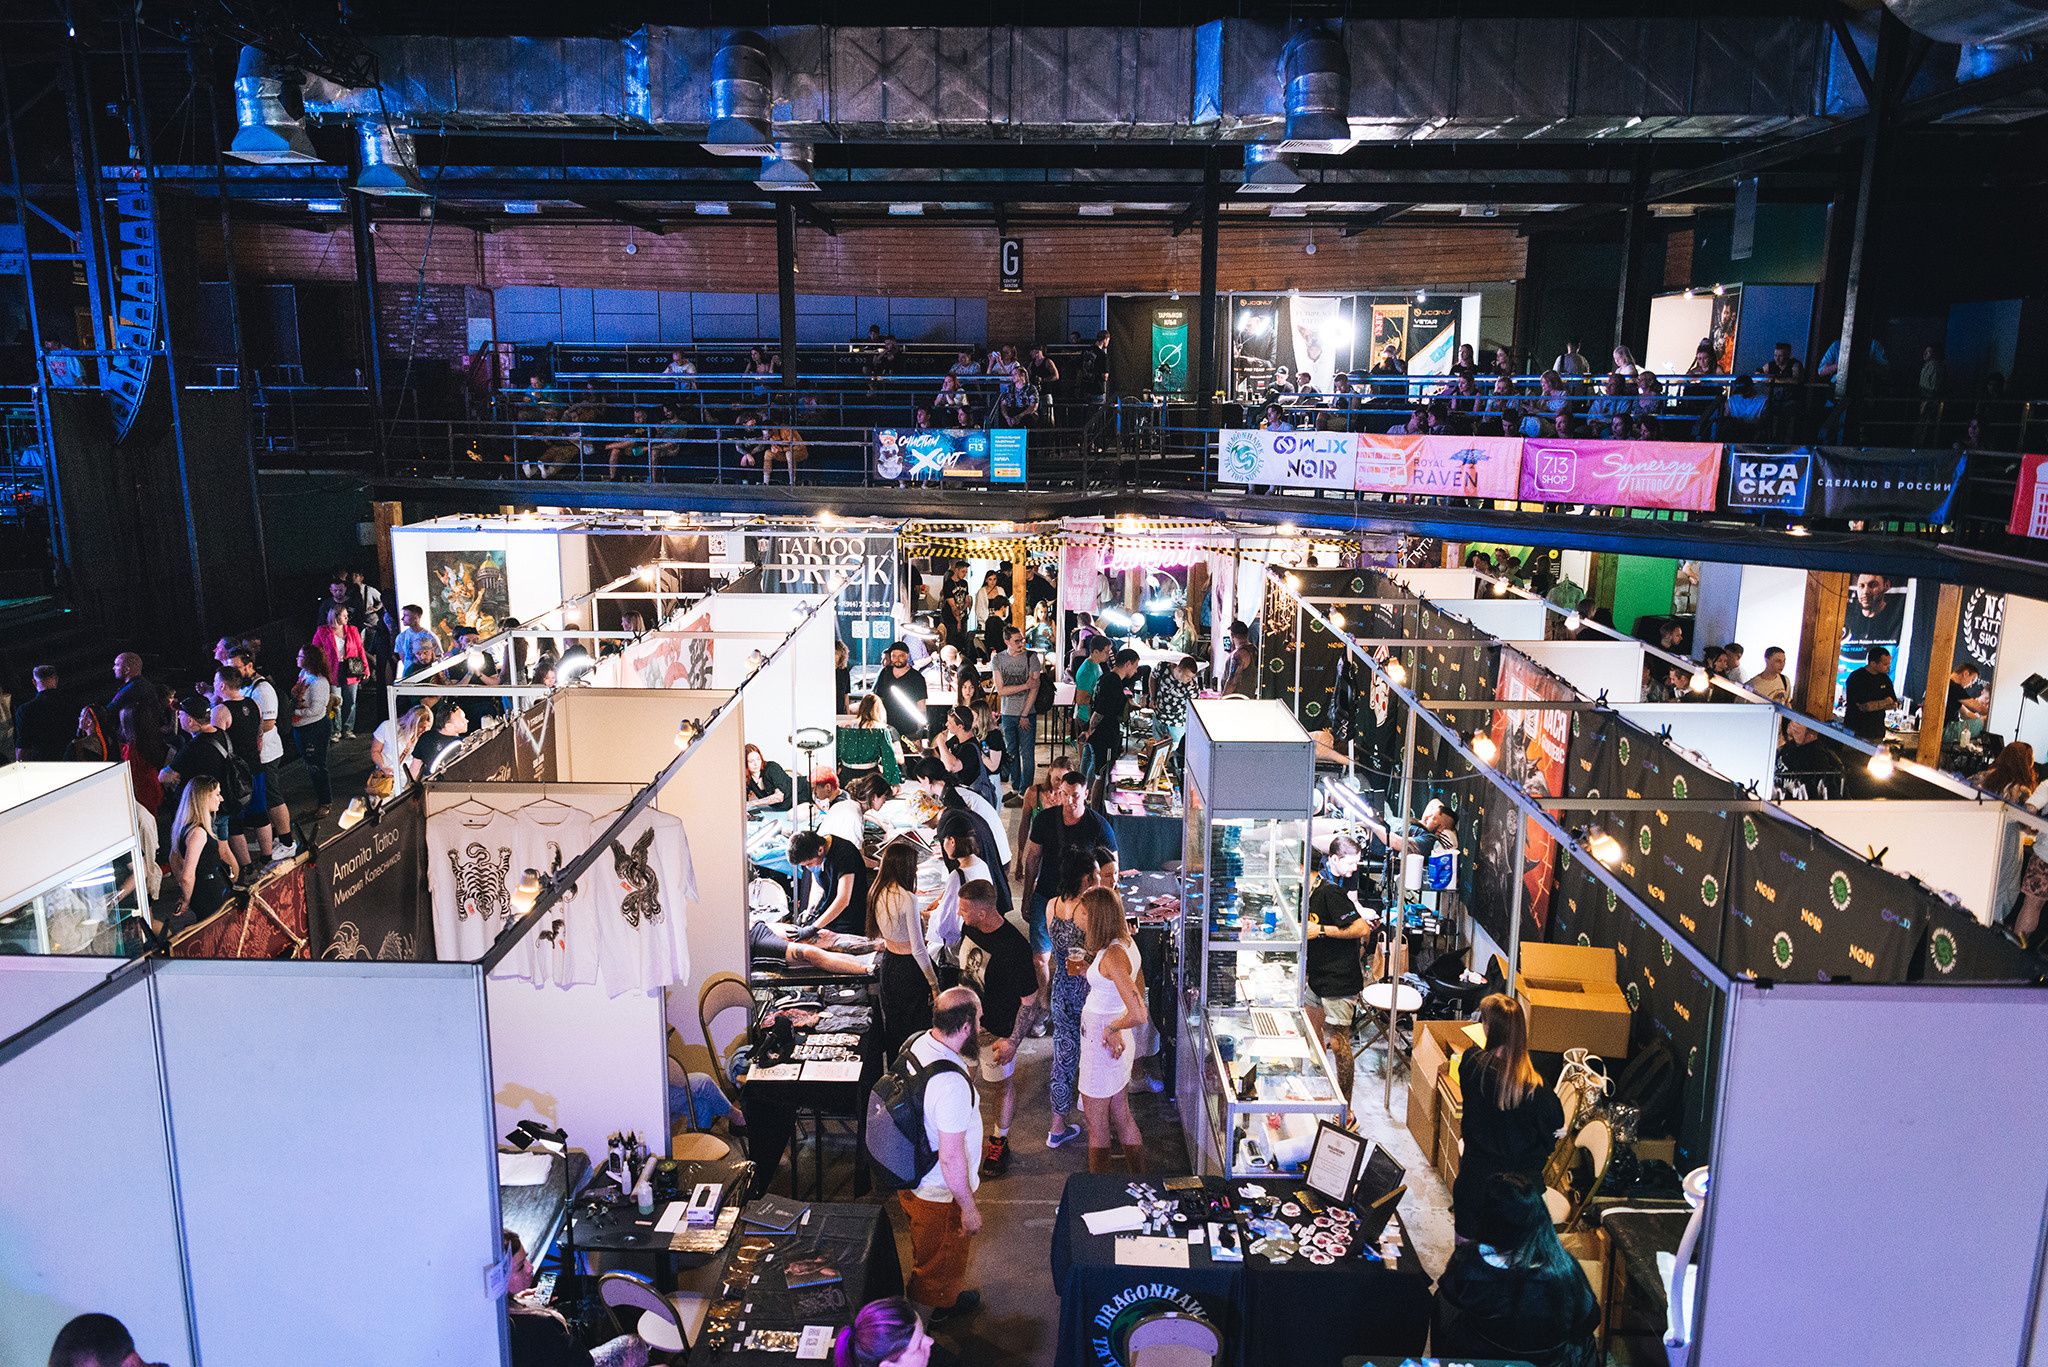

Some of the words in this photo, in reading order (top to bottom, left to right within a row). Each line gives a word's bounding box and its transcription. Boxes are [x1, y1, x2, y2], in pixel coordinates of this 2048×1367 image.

[1003, 241, 1019, 276] G
[968, 444, 984, 452] F13
[1224, 457, 1244, 482] TATTOO
[1245, 458, 1264, 481] SUPPLY
[1287, 458, 1337, 479] NOIR
[1413, 458, 1445, 468] ROYAL
[1592, 453, 1700, 491] Synergy
[1740, 462, 1798, 480] КРА
[1413, 469, 1478, 488] RAVEN
[1541, 475, 1568, 484] SHOP
[1629, 478, 1663, 491] TATTOO
[1737, 479, 1797, 496] СКА
[1817, 478, 1878, 489] СДЕЛАНО
[1884, 480, 1891, 489] В
[1898, 481, 1953, 492] РОССИИ
[778, 537, 866, 556] TATTOO
[779, 553, 891, 586] BRICK
[332, 847, 373, 885] Amanita
[373, 828, 400, 855] Tattoo
[334, 879, 364, 908] Михаил
[364, 851, 402, 885] Колесников
[1754, 879, 1776, 903] NOIR
[1800, 908, 1823, 934] NOIR
[1849, 944, 1875, 969] NOIR
[1094, 1283, 1208, 1331] DRAGONHAW
[1092, 1336, 1123, 1367] TAT
